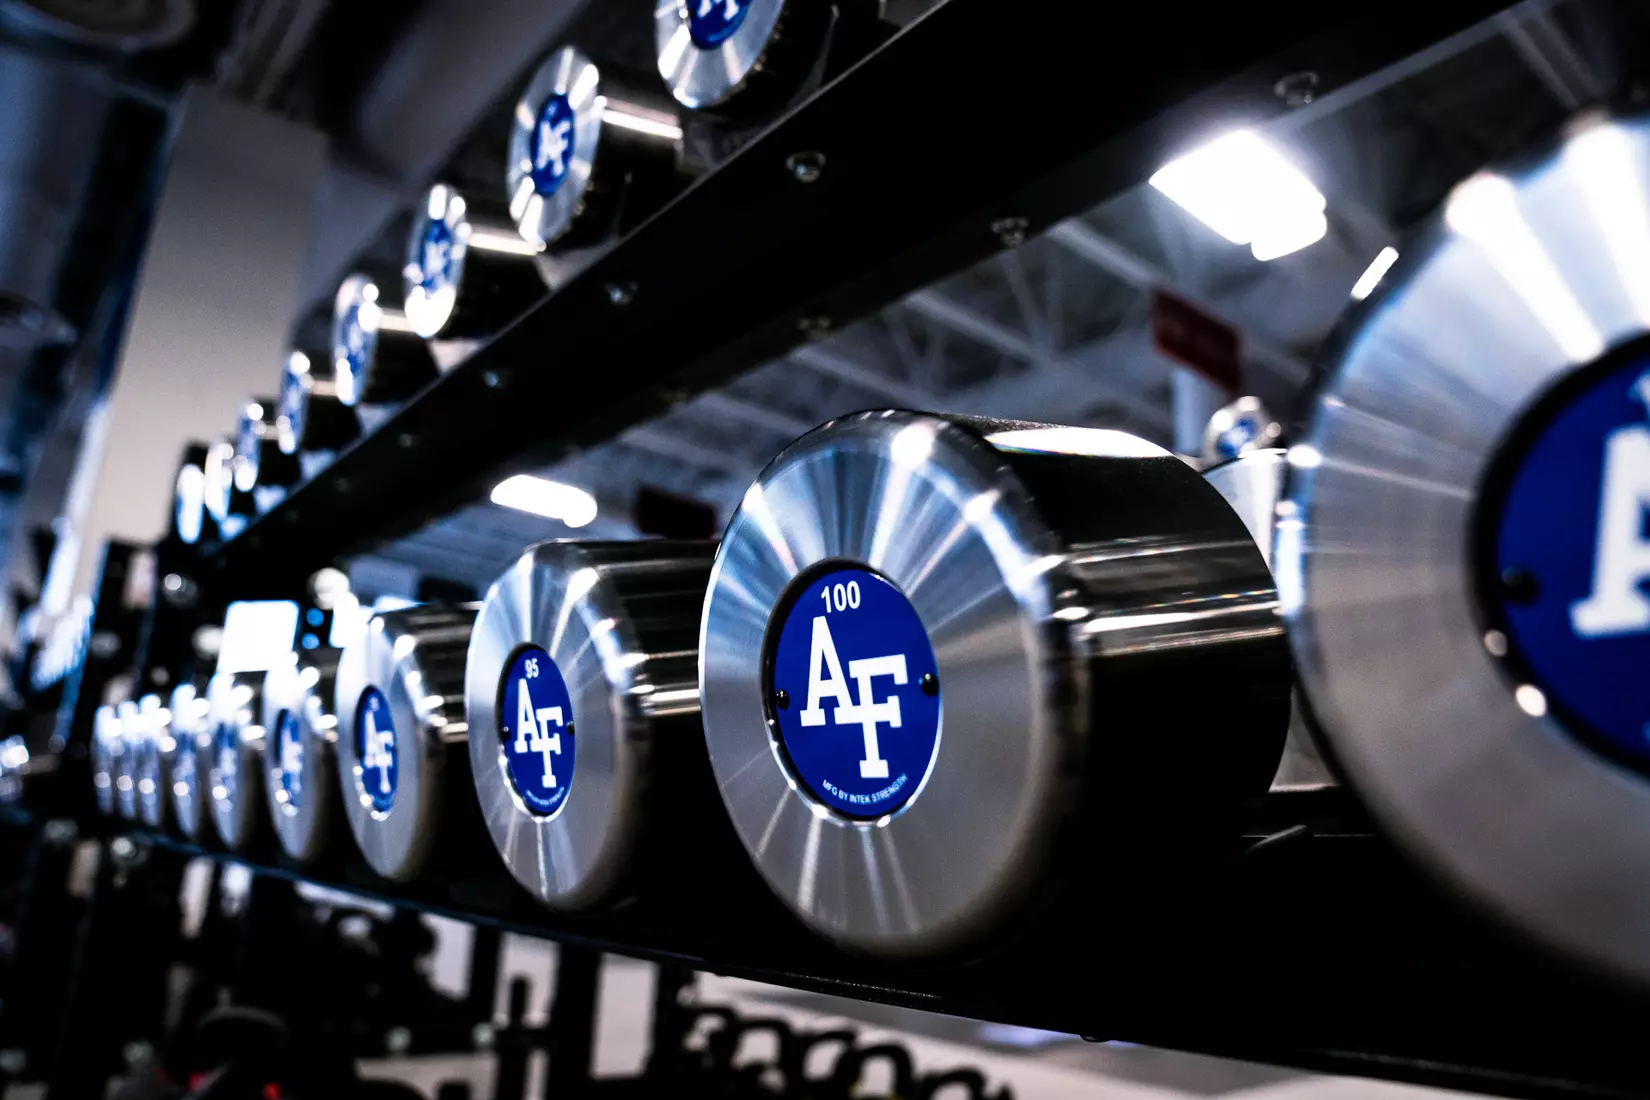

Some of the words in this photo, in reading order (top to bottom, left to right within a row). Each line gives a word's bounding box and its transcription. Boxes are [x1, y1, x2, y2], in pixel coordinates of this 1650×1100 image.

[820, 580, 862, 614] 100
[524, 657, 540, 680] 95
[800, 615, 909, 779] AF
[514, 677, 564, 788] AF
[822, 779, 838, 796] MFG
[838, 789, 849, 801] BY
